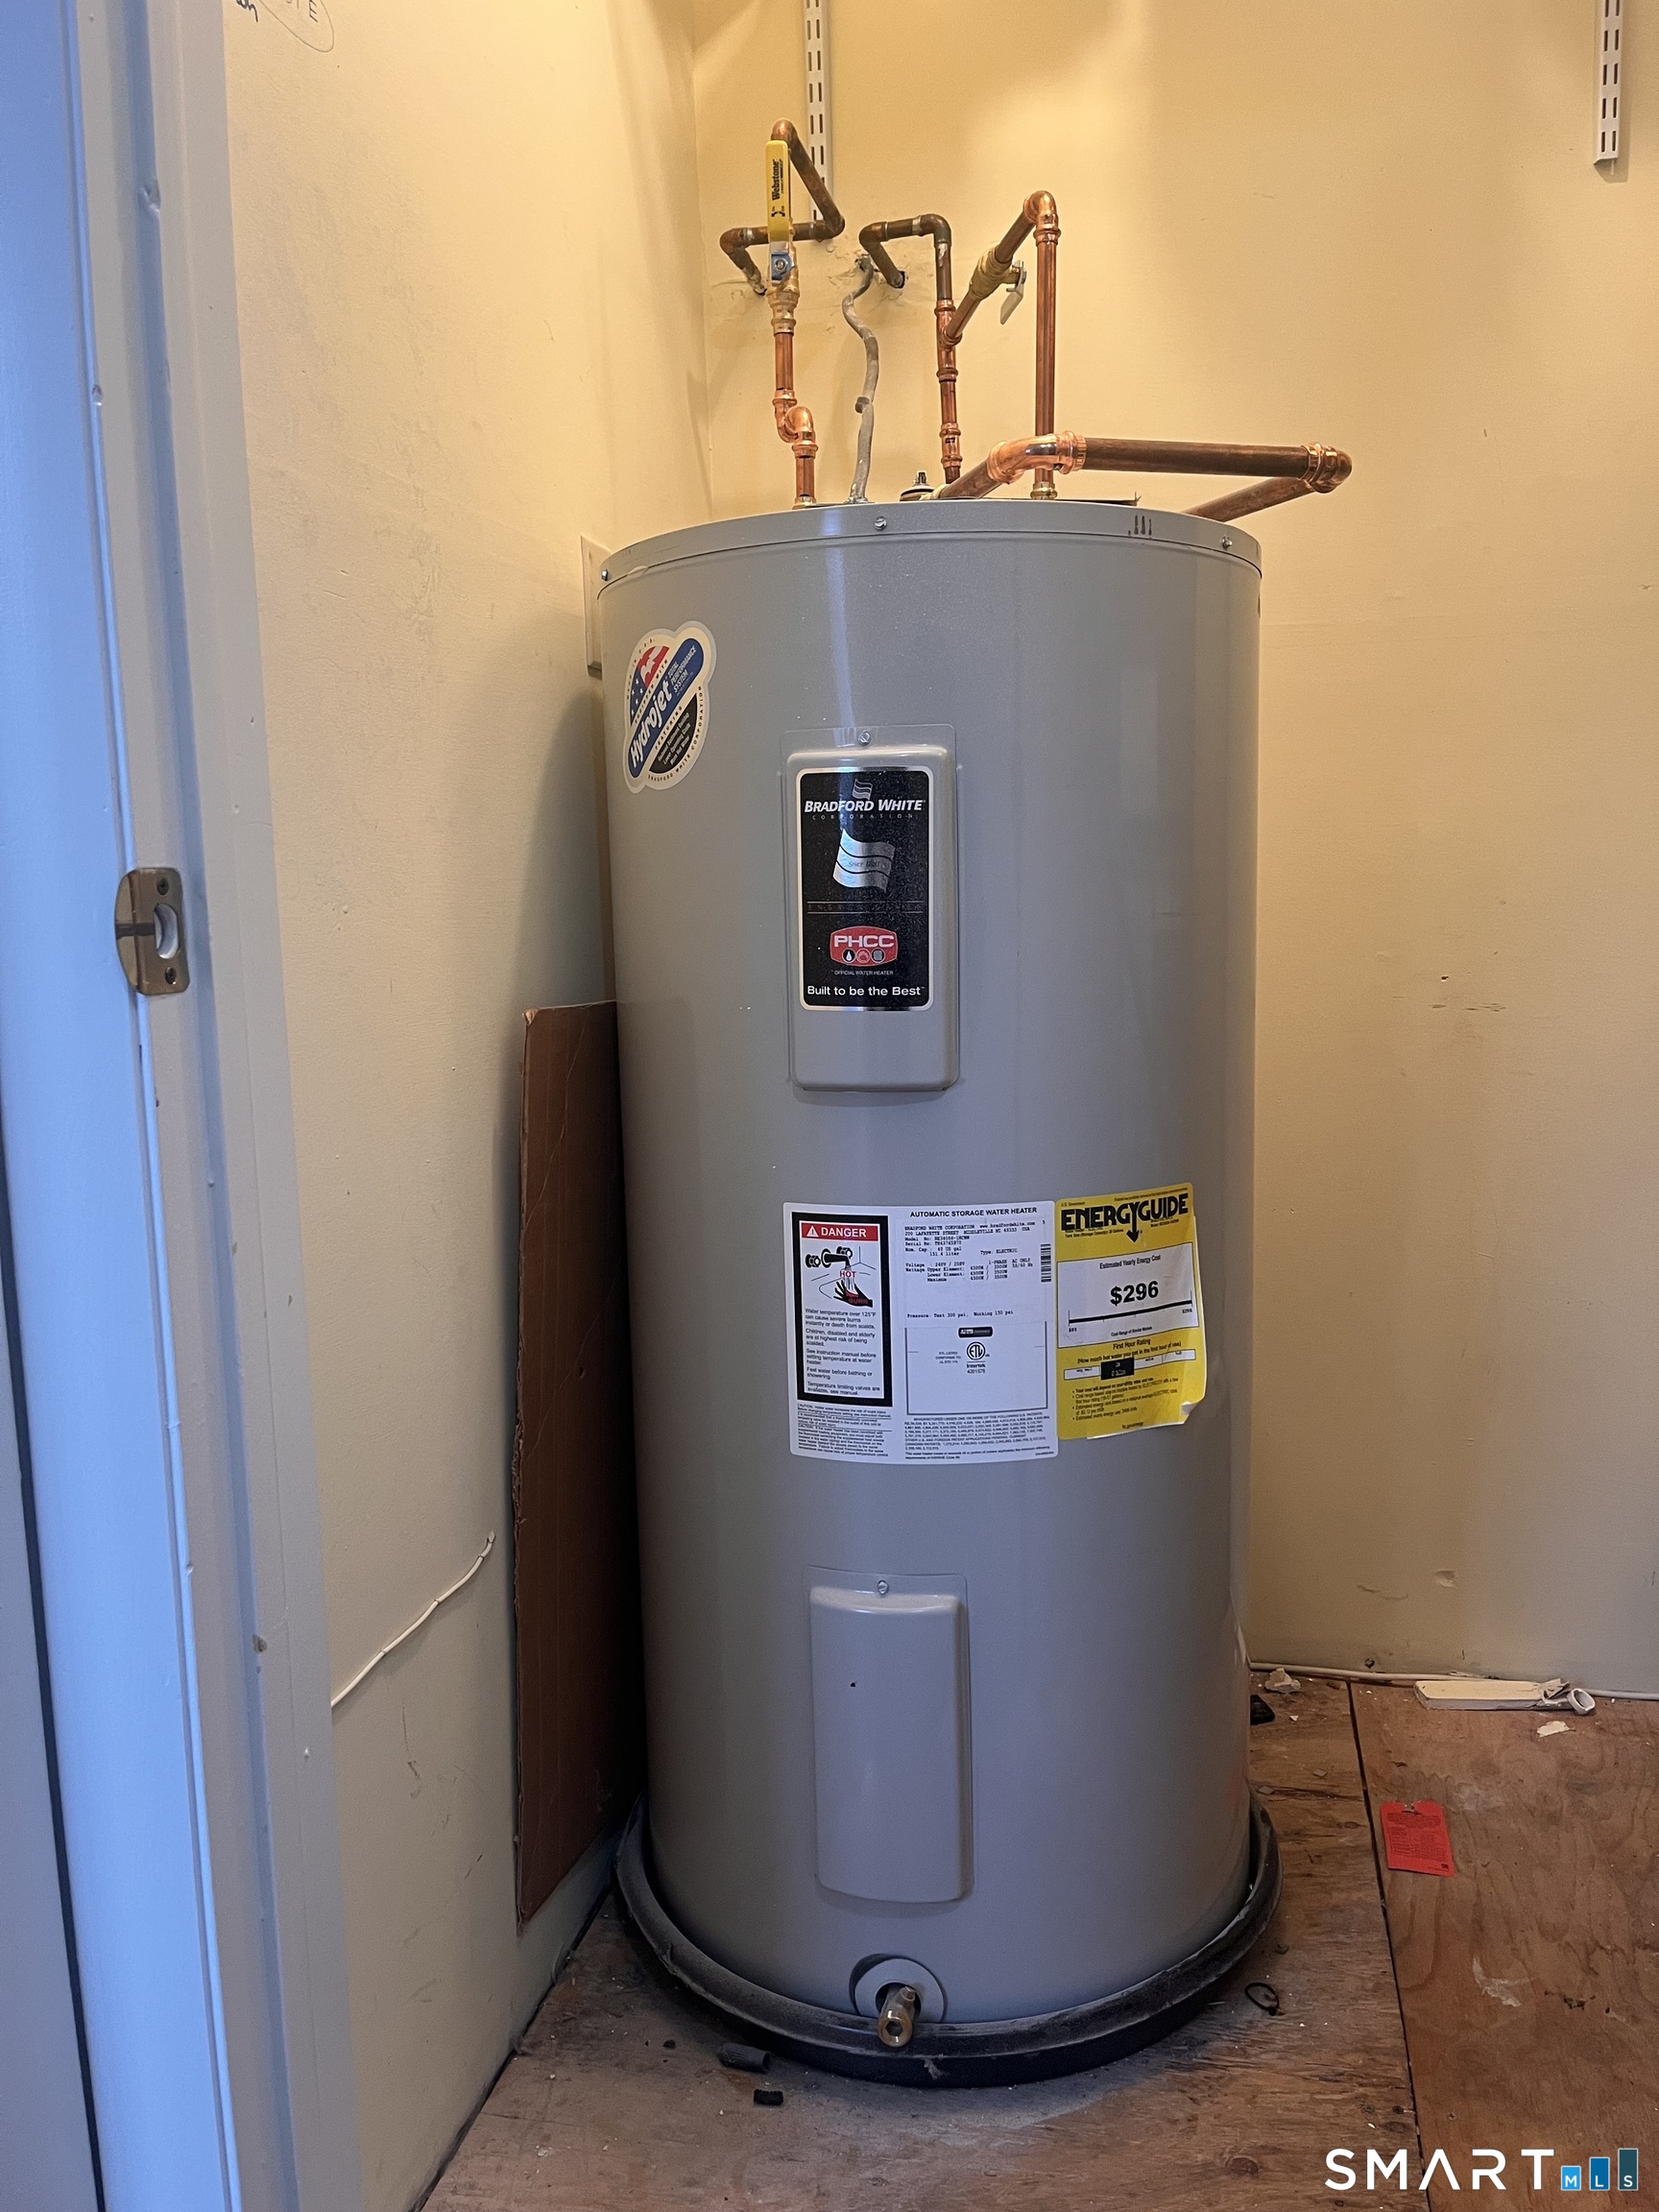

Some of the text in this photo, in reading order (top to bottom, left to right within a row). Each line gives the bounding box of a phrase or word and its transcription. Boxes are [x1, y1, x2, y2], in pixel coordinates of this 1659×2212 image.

[671, 645, 697, 685] PERFORMANCE
[635, 659, 668, 725] EQUIPPED WITH
[673, 669, 688, 693] SYSTEM
[630, 680, 672, 768] Hydrojet
[655, 706, 683, 751] FEATURING
[676, 754, 691, 772] WHITE
[690, 685, 704, 751] CORPORATION
[804, 799, 924, 813] BRADFORD WHITE
[834, 935, 894, 947] PHCC
[807, 986, 921, 996] Built to be the Best
[1061, 1193, 1188, 1232] ENERGYGUIDE
[821, 1227, 867, 1237] DANGER
[1100, 1261, 1122, 1269] Estimated
[1123, 1259, 1136, 1267] Yearly
[1137, 1257, 1151, 1265] Energy
[848, 1296, 869, 1304] BURN
[1110, 1281, 1159, 1306] $296
